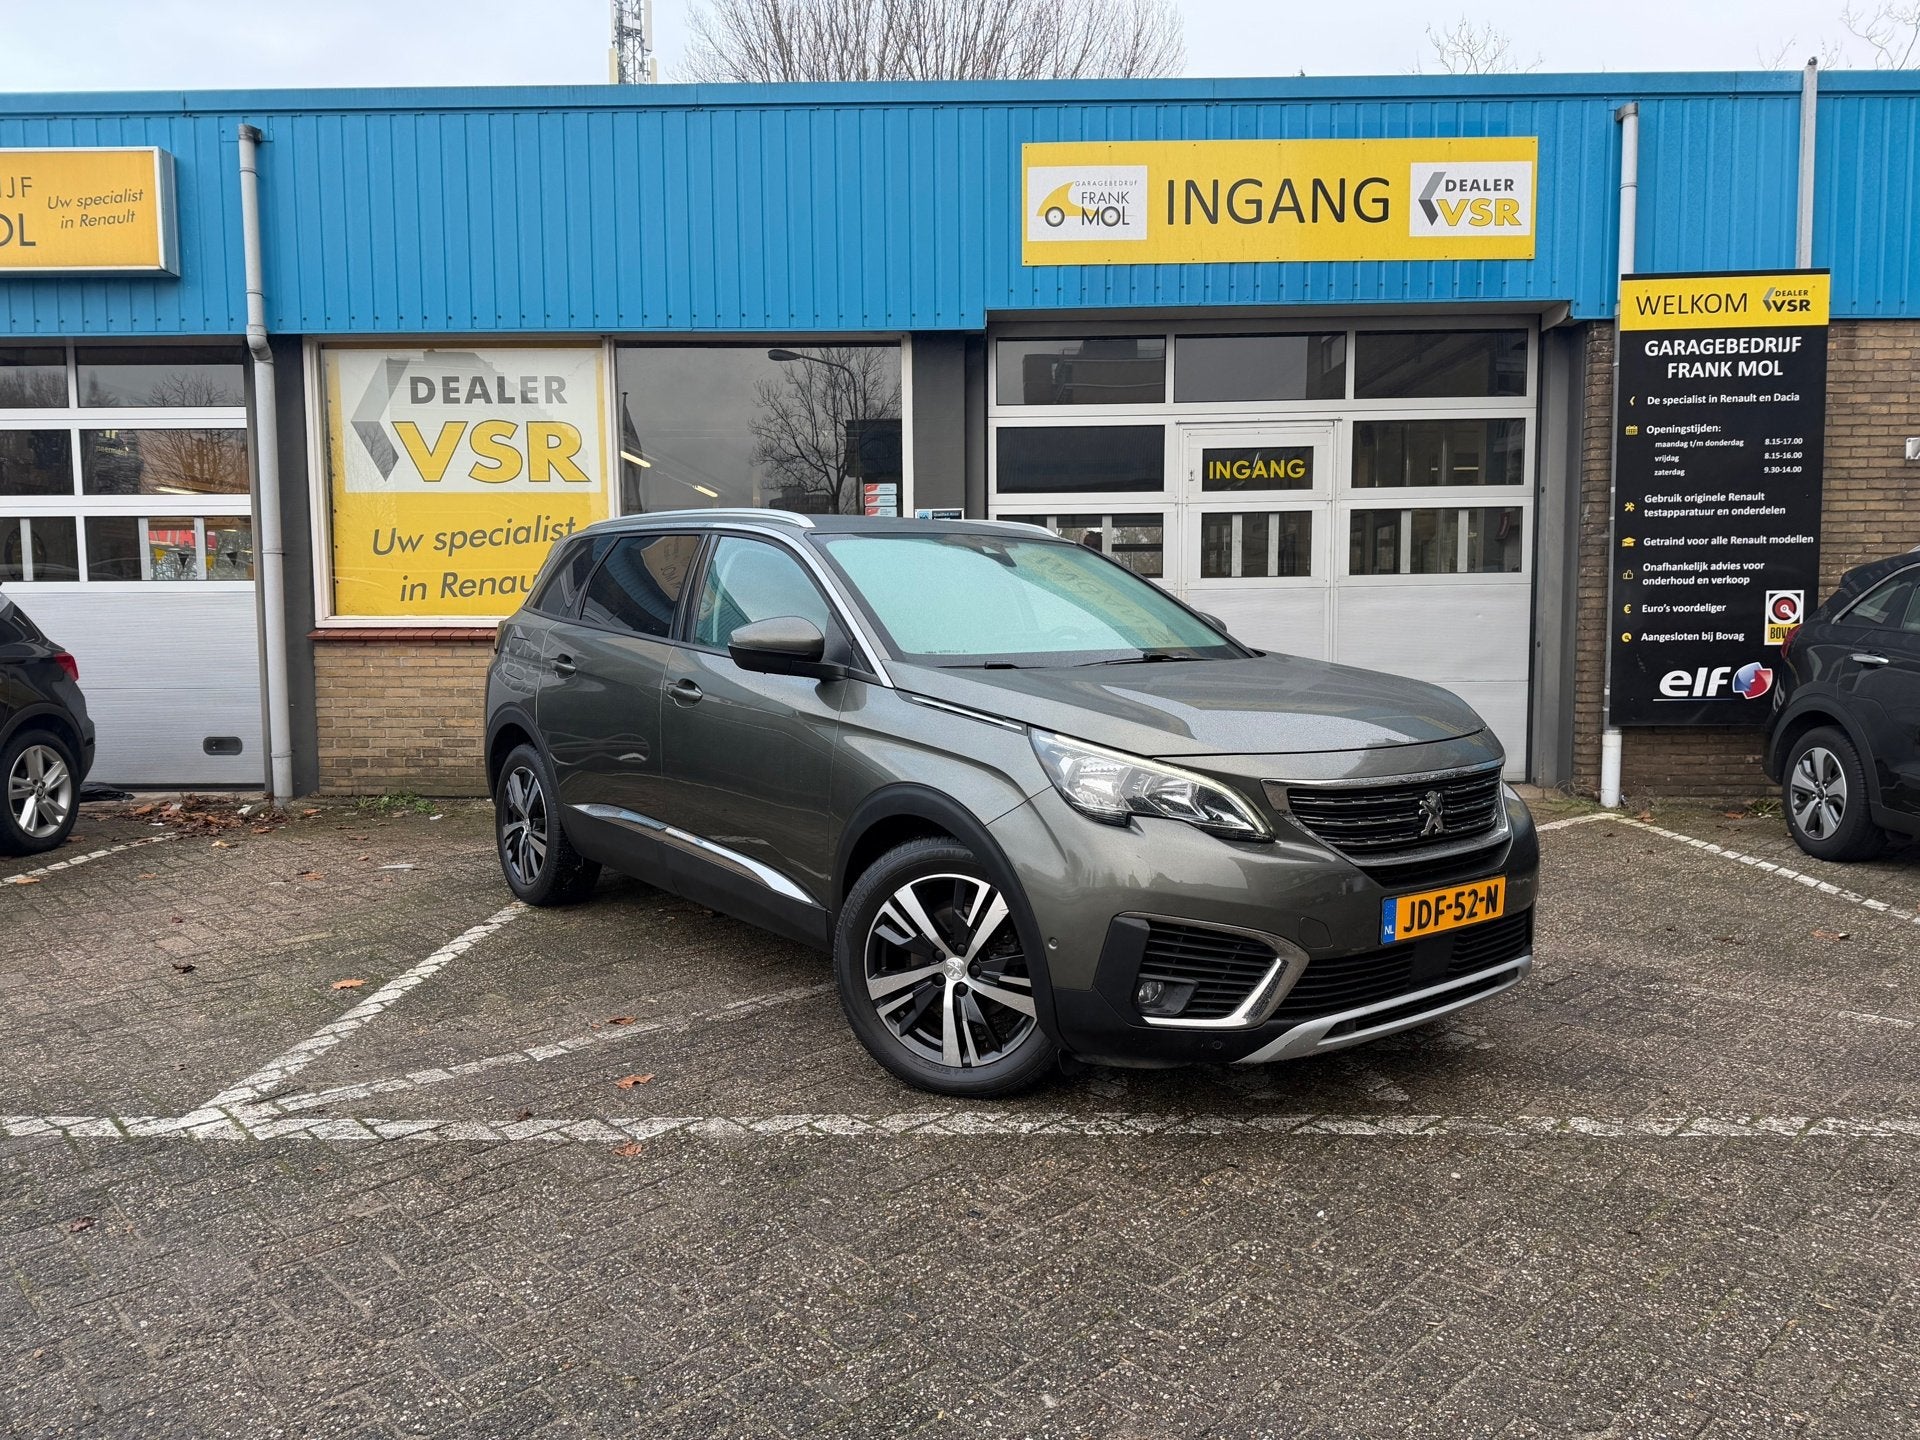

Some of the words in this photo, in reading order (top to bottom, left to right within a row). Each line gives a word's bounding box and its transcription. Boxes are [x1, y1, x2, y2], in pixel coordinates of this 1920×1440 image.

[1445, 179, 1514, 192] DEALER
[47, 196, 72, 210] Uw
[76, 188, 144, 209] specialist
[1081, 191, 1130, 204] FRANK
[1167, 176, 1391, 225] INGANG
[60, 216, 74, 229] in
[79, 209, 136, 228] Renault
[1081, 206, 1130, 227] MOL
[1436, 198, 1522, 227] VSR
[1775, 289, 1809, 297] DEALER
[1635, 293, 1748, 316] WELKOM
[1771, 299, 1812, 313] VSR
[1644, 336, 1802, 357] GARAGEBEDRIJF
[1667, 362, 1733, 379] FRANK
[1738, 360, 1784, 377] MOL
[409, 375, 568, 405] DEALER
[1647, 396, 1661, 405] De
[1662, 394, 1706, 406] specialist
[1708, 394, 1718, 404] in
[1720, 393, 1757, 403] Renault
[1759, 394, 1771, 402] en
[1773, 392, 1800, 402] Dacia
[1646, 423, 1722, 435] Openingstijden:
[1655, 440, 1689, 449] maandag
[1690, 440, 1704, 448] t/m
[1705, 439, 1744, 447] donderdag
[1764, 437, 1803, 446] 8.15-17.00
[391, 419, 592, 484] VSR
[1764, 451, 1803, 460] 8.15-16.00
[1654, 455, 1680, 463] vrijdag
[1208, 459, 1306, 480] INGANG
[1654, 468, 1686, 477] zaterdag
[1763, 465, 1803, 474] 9.30-14.00
[1644, 493, 1683, 503] Gebruik
[1684, 493, 1727, 504] originele
[1728, 492, 1766, 502] Renault
[1644, 508, 1715, 519] testapparatuur
[1716, 508, 1729, 516] en
[1731, 506, 1786, 516] onderdelen
[372, 527, 424, 556] Uw
[433, 514, 576, 556] specialist
[1643, 536, 1685, 546] Getraind
[1687, 537, 1709, 546] voor
[1710, 535, 1728, 545] alle
[1730, 535, 1767, 545] Renault
[1769, 534, 1814, 544] modellen
[1642, 561, 1709, 572] Onafhankelijk
[1710, 561, 1741, 571] advies
[1743, 562, 1765, 570] voor
[1642, 575, 1695, 586] onderhoud
[1697, 577, 1710, 585] en
[1711, 575, 1750, 587] verkoop
[400, 575, 427, 602] in
[1672, 603, 1727, 615] voordeliger
[1641, 631, 1700, 643] Aangesloten
[1701, 631, 1714, 644] bij
[1715, 631, 1745, 643] Bovag
[1770, 626, 1791, 640] BOV
[1658, 666, 1732, 698] elf
[1403, 884, 1499, 933] JDF-52-N
[1384, 926, 1395, 936] NL
